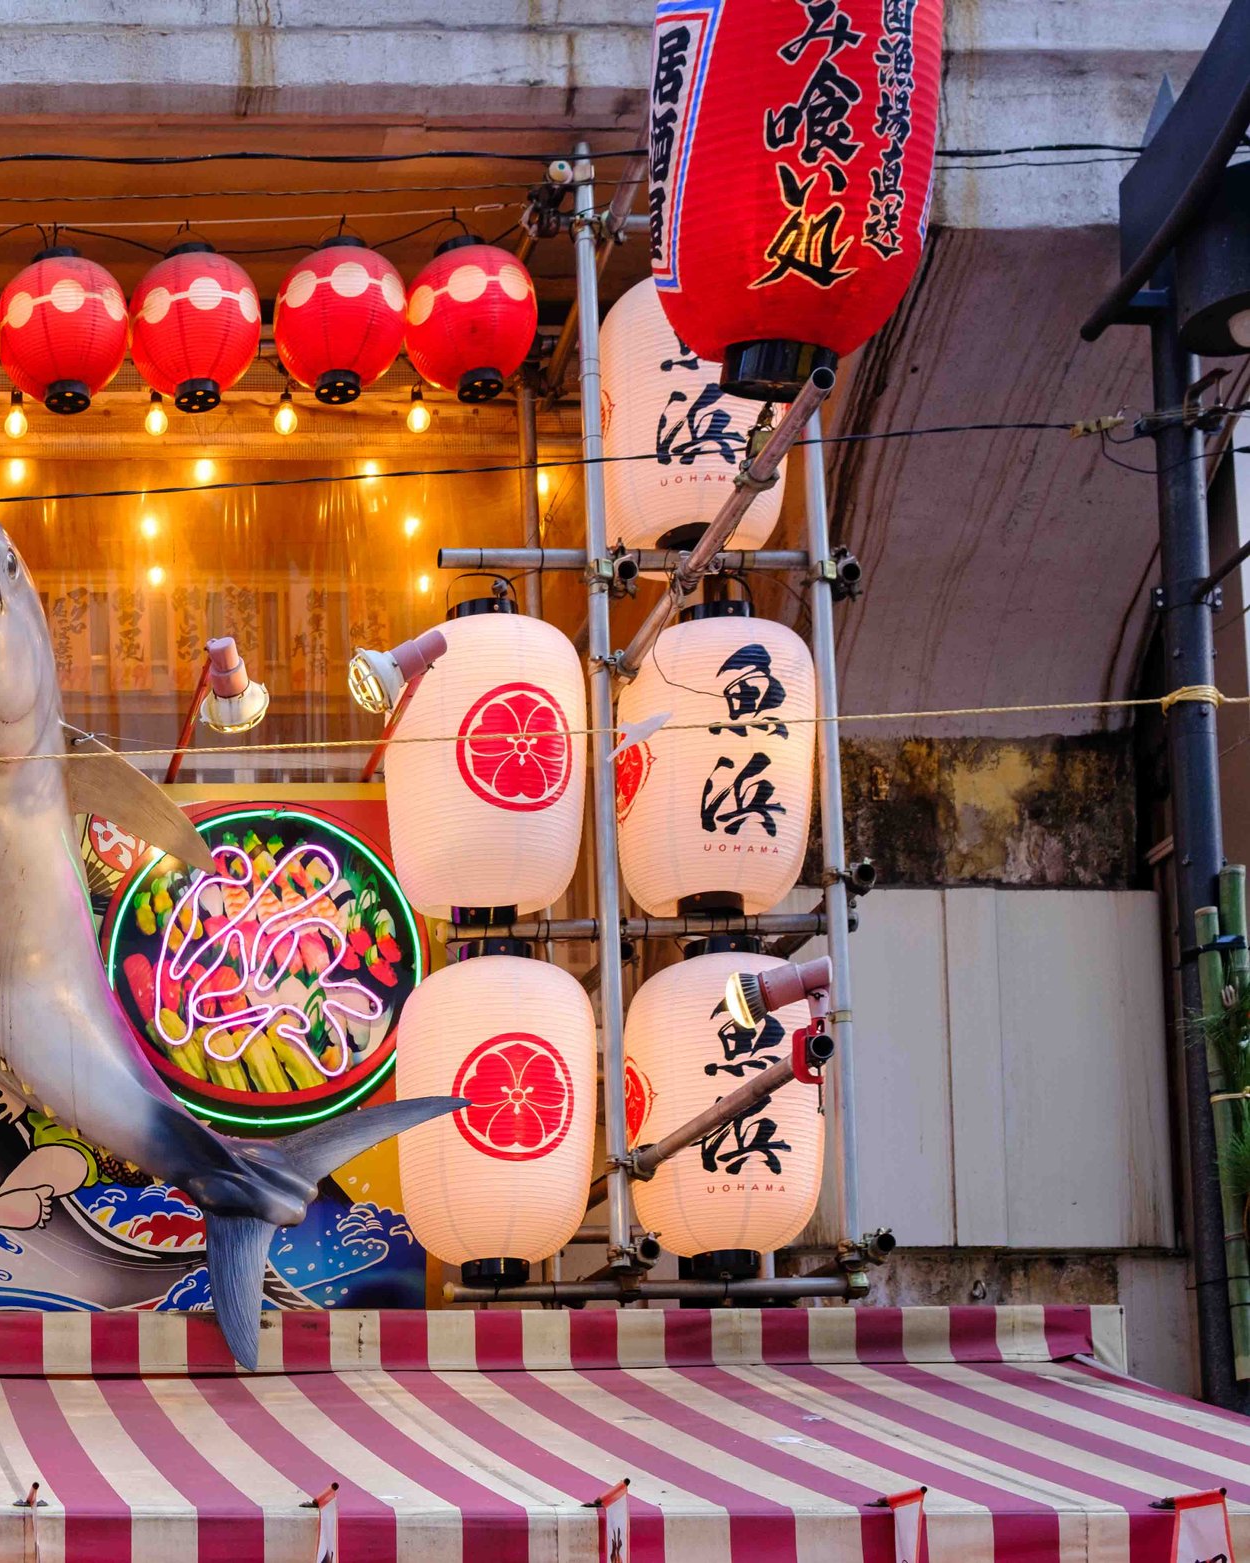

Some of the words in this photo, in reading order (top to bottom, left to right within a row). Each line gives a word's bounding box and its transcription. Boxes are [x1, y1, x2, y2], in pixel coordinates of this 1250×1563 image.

[661, 473, 734, 487] UOHAM
[699, 642, 789, 838] 魚浜
[702, 843, 781, 855] UOHAMA
[706, 1183, 786, 1194] UOHAMA
